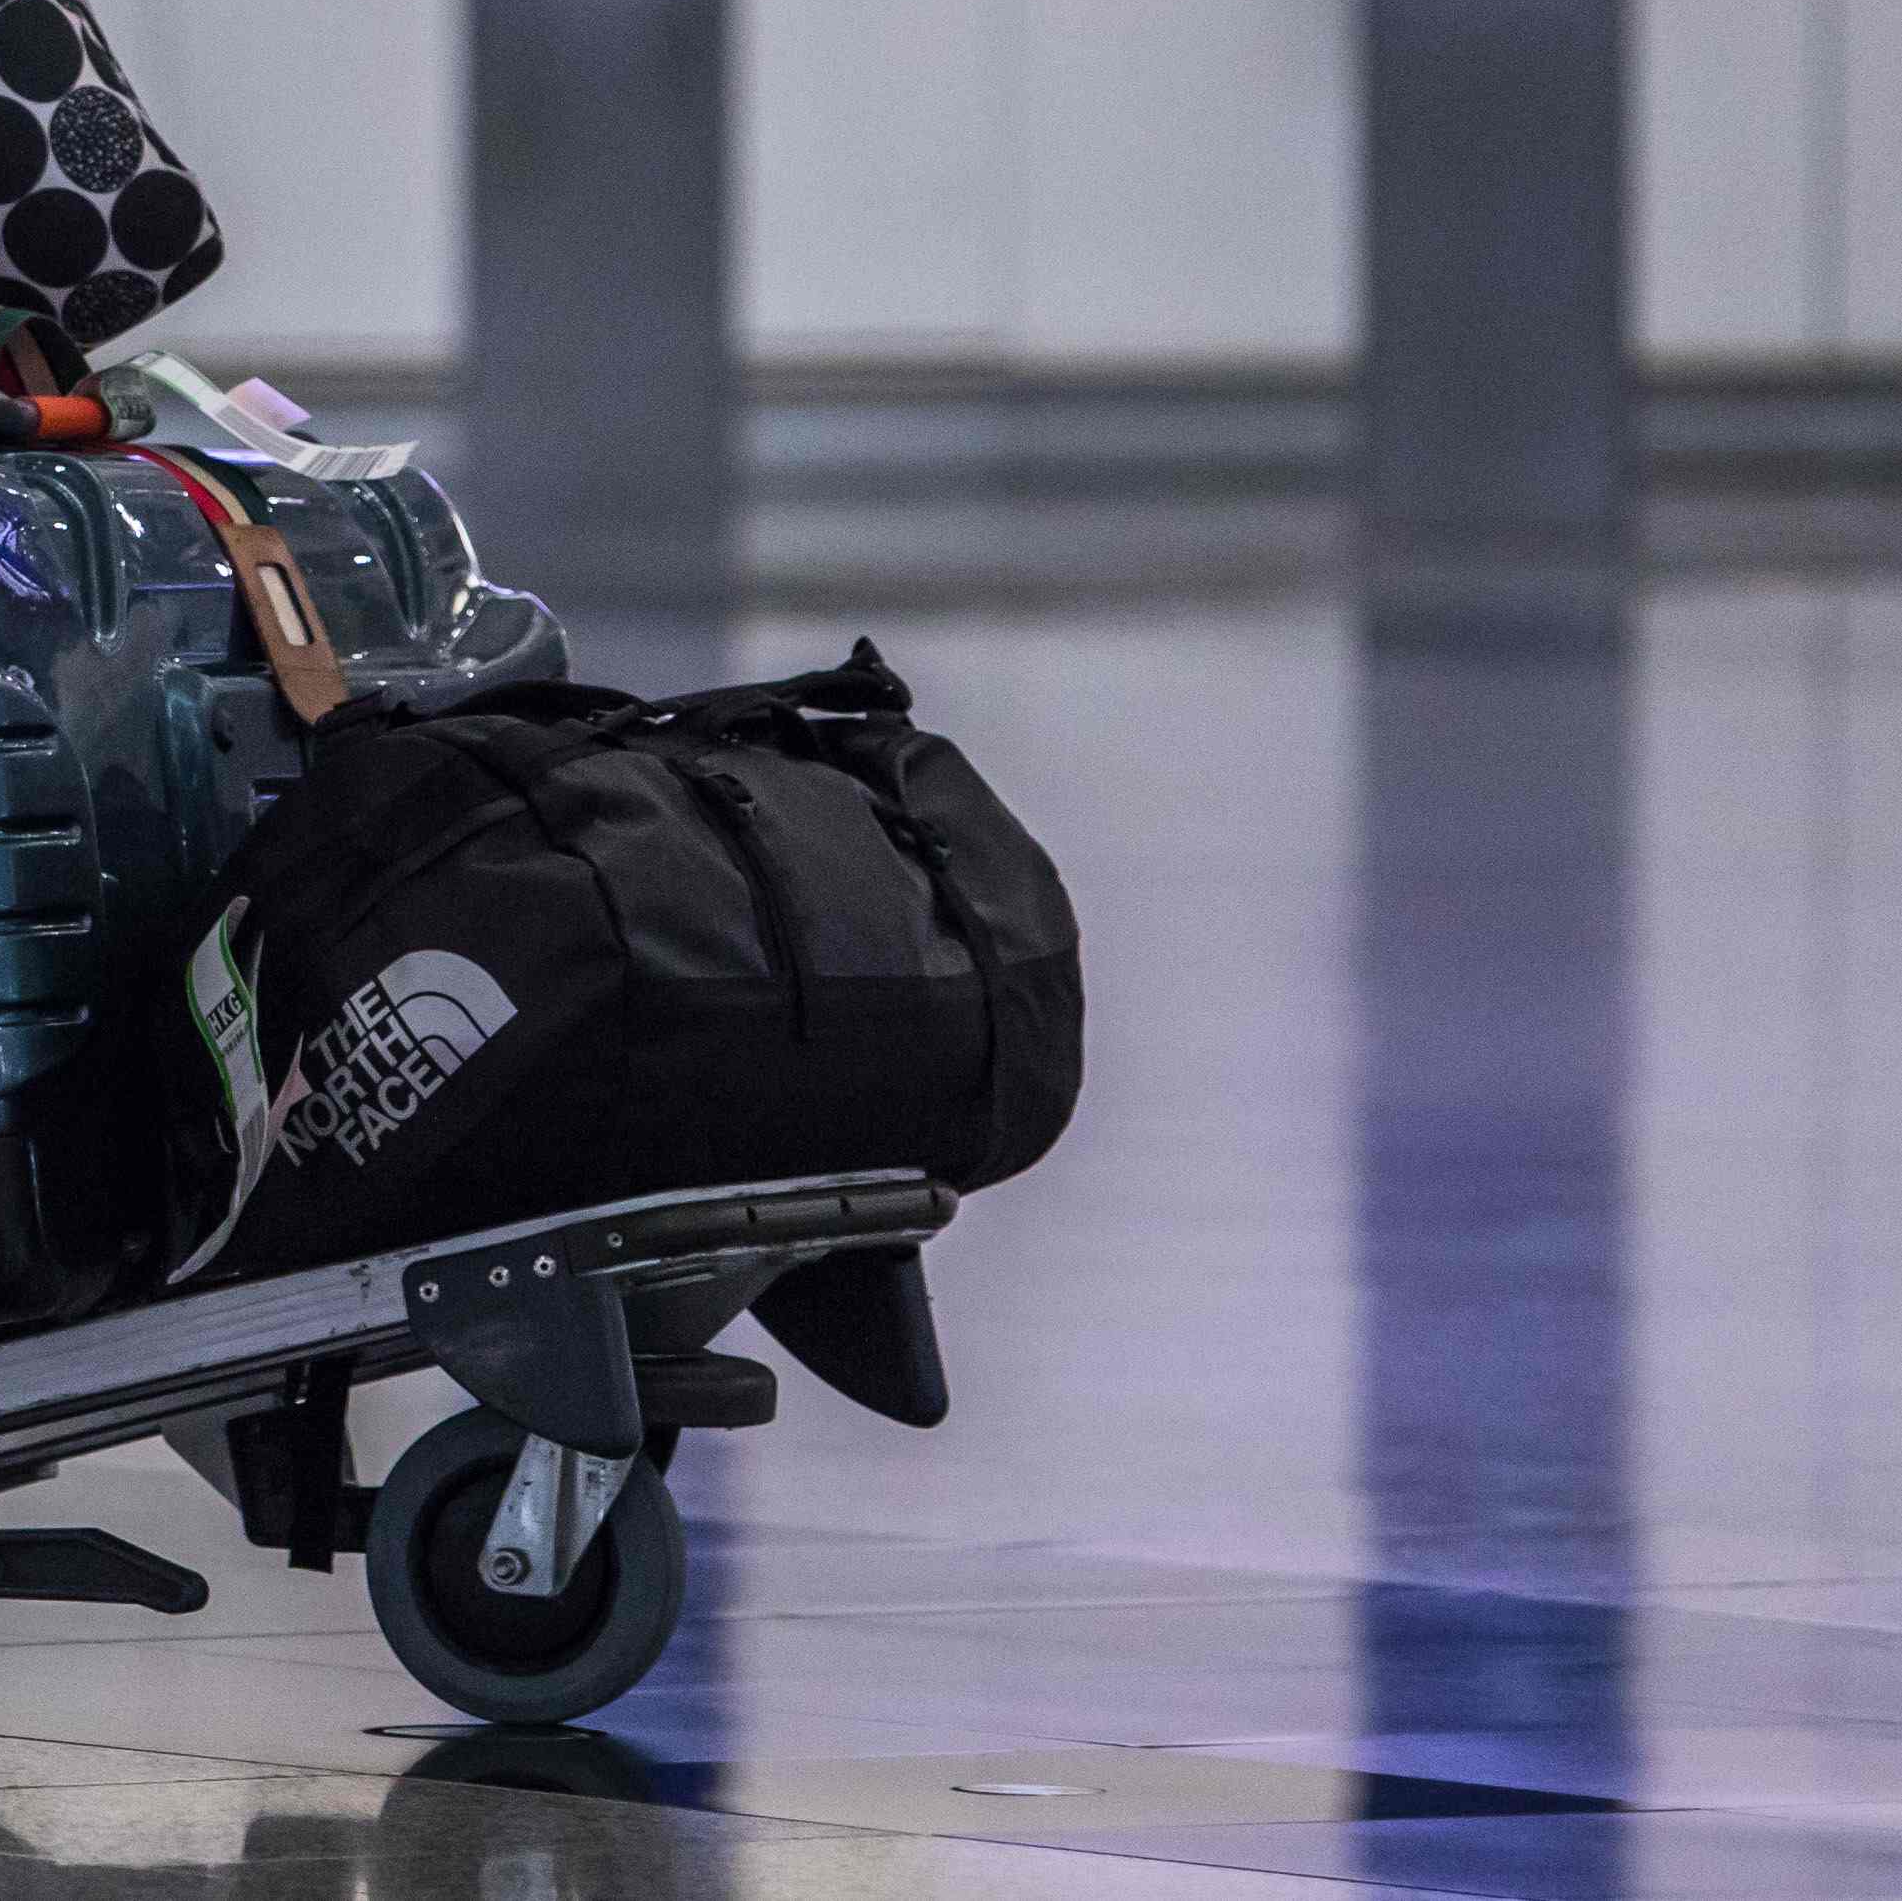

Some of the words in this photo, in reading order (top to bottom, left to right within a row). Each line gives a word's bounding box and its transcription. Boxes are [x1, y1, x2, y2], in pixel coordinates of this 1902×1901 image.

[206, 990, 244, 1037] HKG
[307, 980, 392, 1070] THE
[277, 1013, 416, 1168] NORTH
[334, 1049, 446, 1167] FACE
